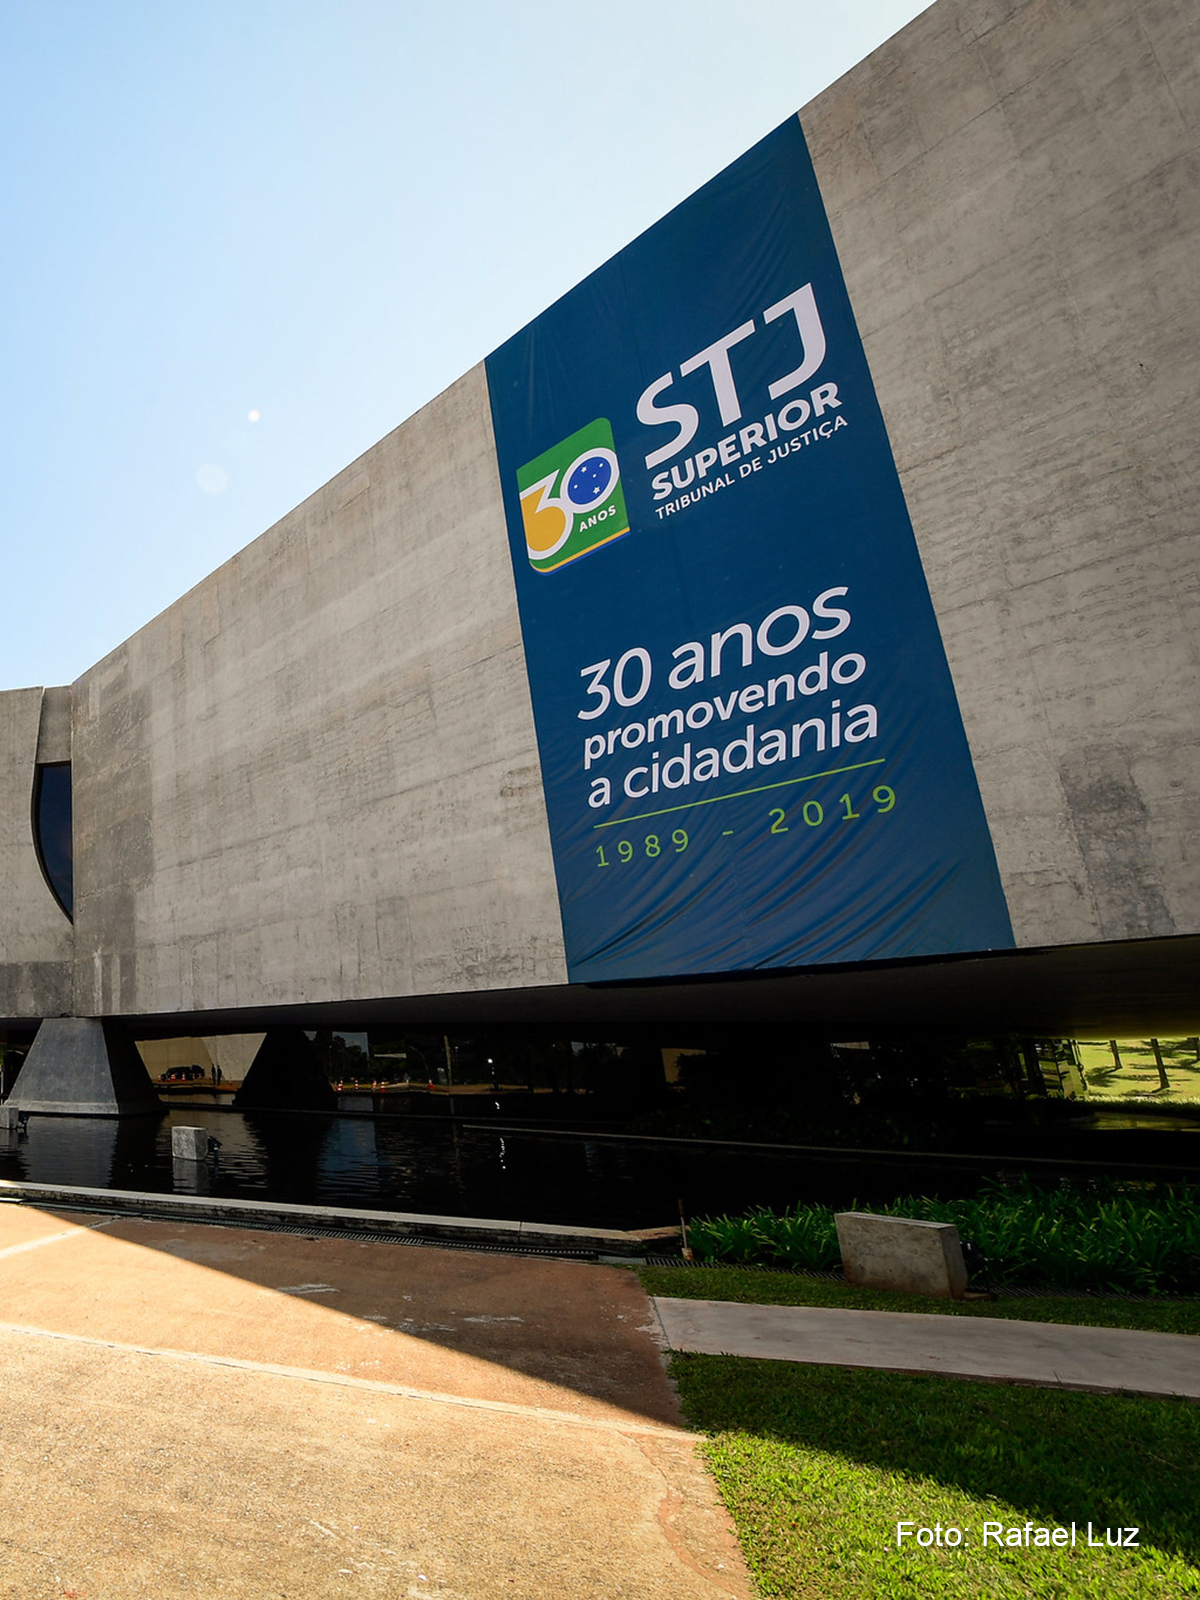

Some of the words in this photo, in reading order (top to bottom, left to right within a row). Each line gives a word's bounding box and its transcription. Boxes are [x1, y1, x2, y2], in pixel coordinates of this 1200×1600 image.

[635, 282, 827, 470] STJ
[651, 382, 843, 500] SUPERIOR
[655, 473, 735, 520] TRIBUNAL
[739, 457, 763, 479] DE
[767, 415, 848, 464] JUSTIÇA
[519, 447, 621, 560] 30
[578, 505, 617, 533] ANOS
[577, 647, 651, 720] 30
[668, 586, 851, 690] anos
[583, 651, 867, 770] promovendo
[588, 777, 611, 808] a
[623, 699, 878, 798] cidadania
[595, 829, 689, 867] 1989
[768, 785, 896, 834] 2019
